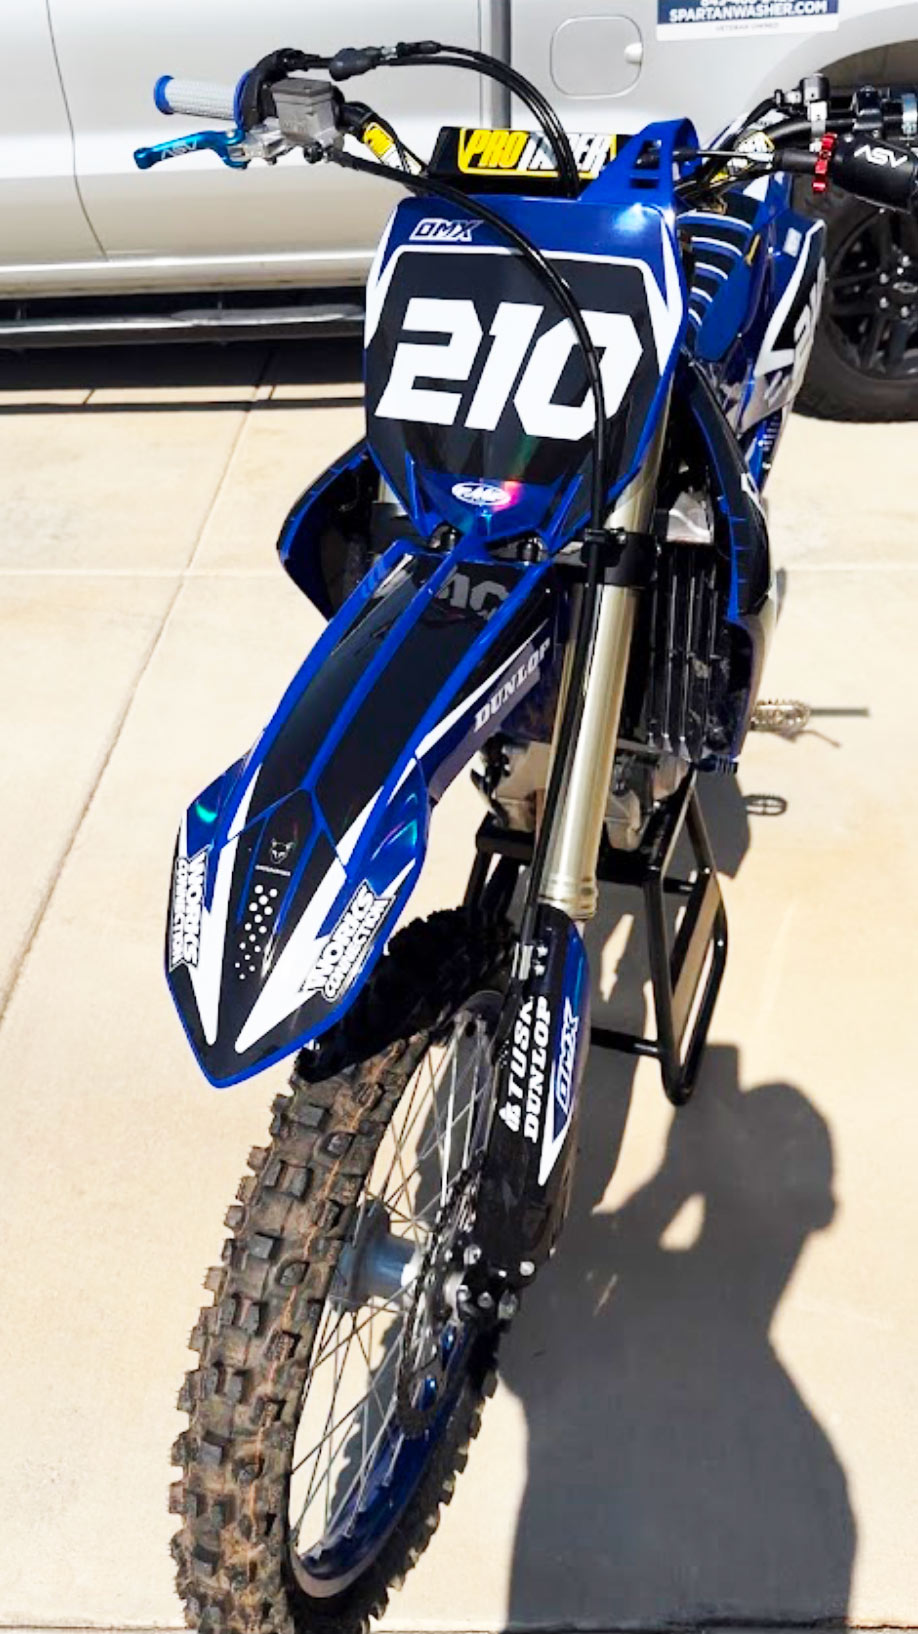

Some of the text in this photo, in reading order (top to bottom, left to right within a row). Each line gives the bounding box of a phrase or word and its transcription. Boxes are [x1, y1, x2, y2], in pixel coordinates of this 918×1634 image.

[669, 1, 828, 23] SPARTANWASHER.COM
[853, 144, 908, 169] ASV
[373, 296, 644, 441] 210
[474, 637, 550, 732] DUNLOP
[303, 883, 375, 992] WORKS
[524, 996, 551, 1143] DUNLOP
